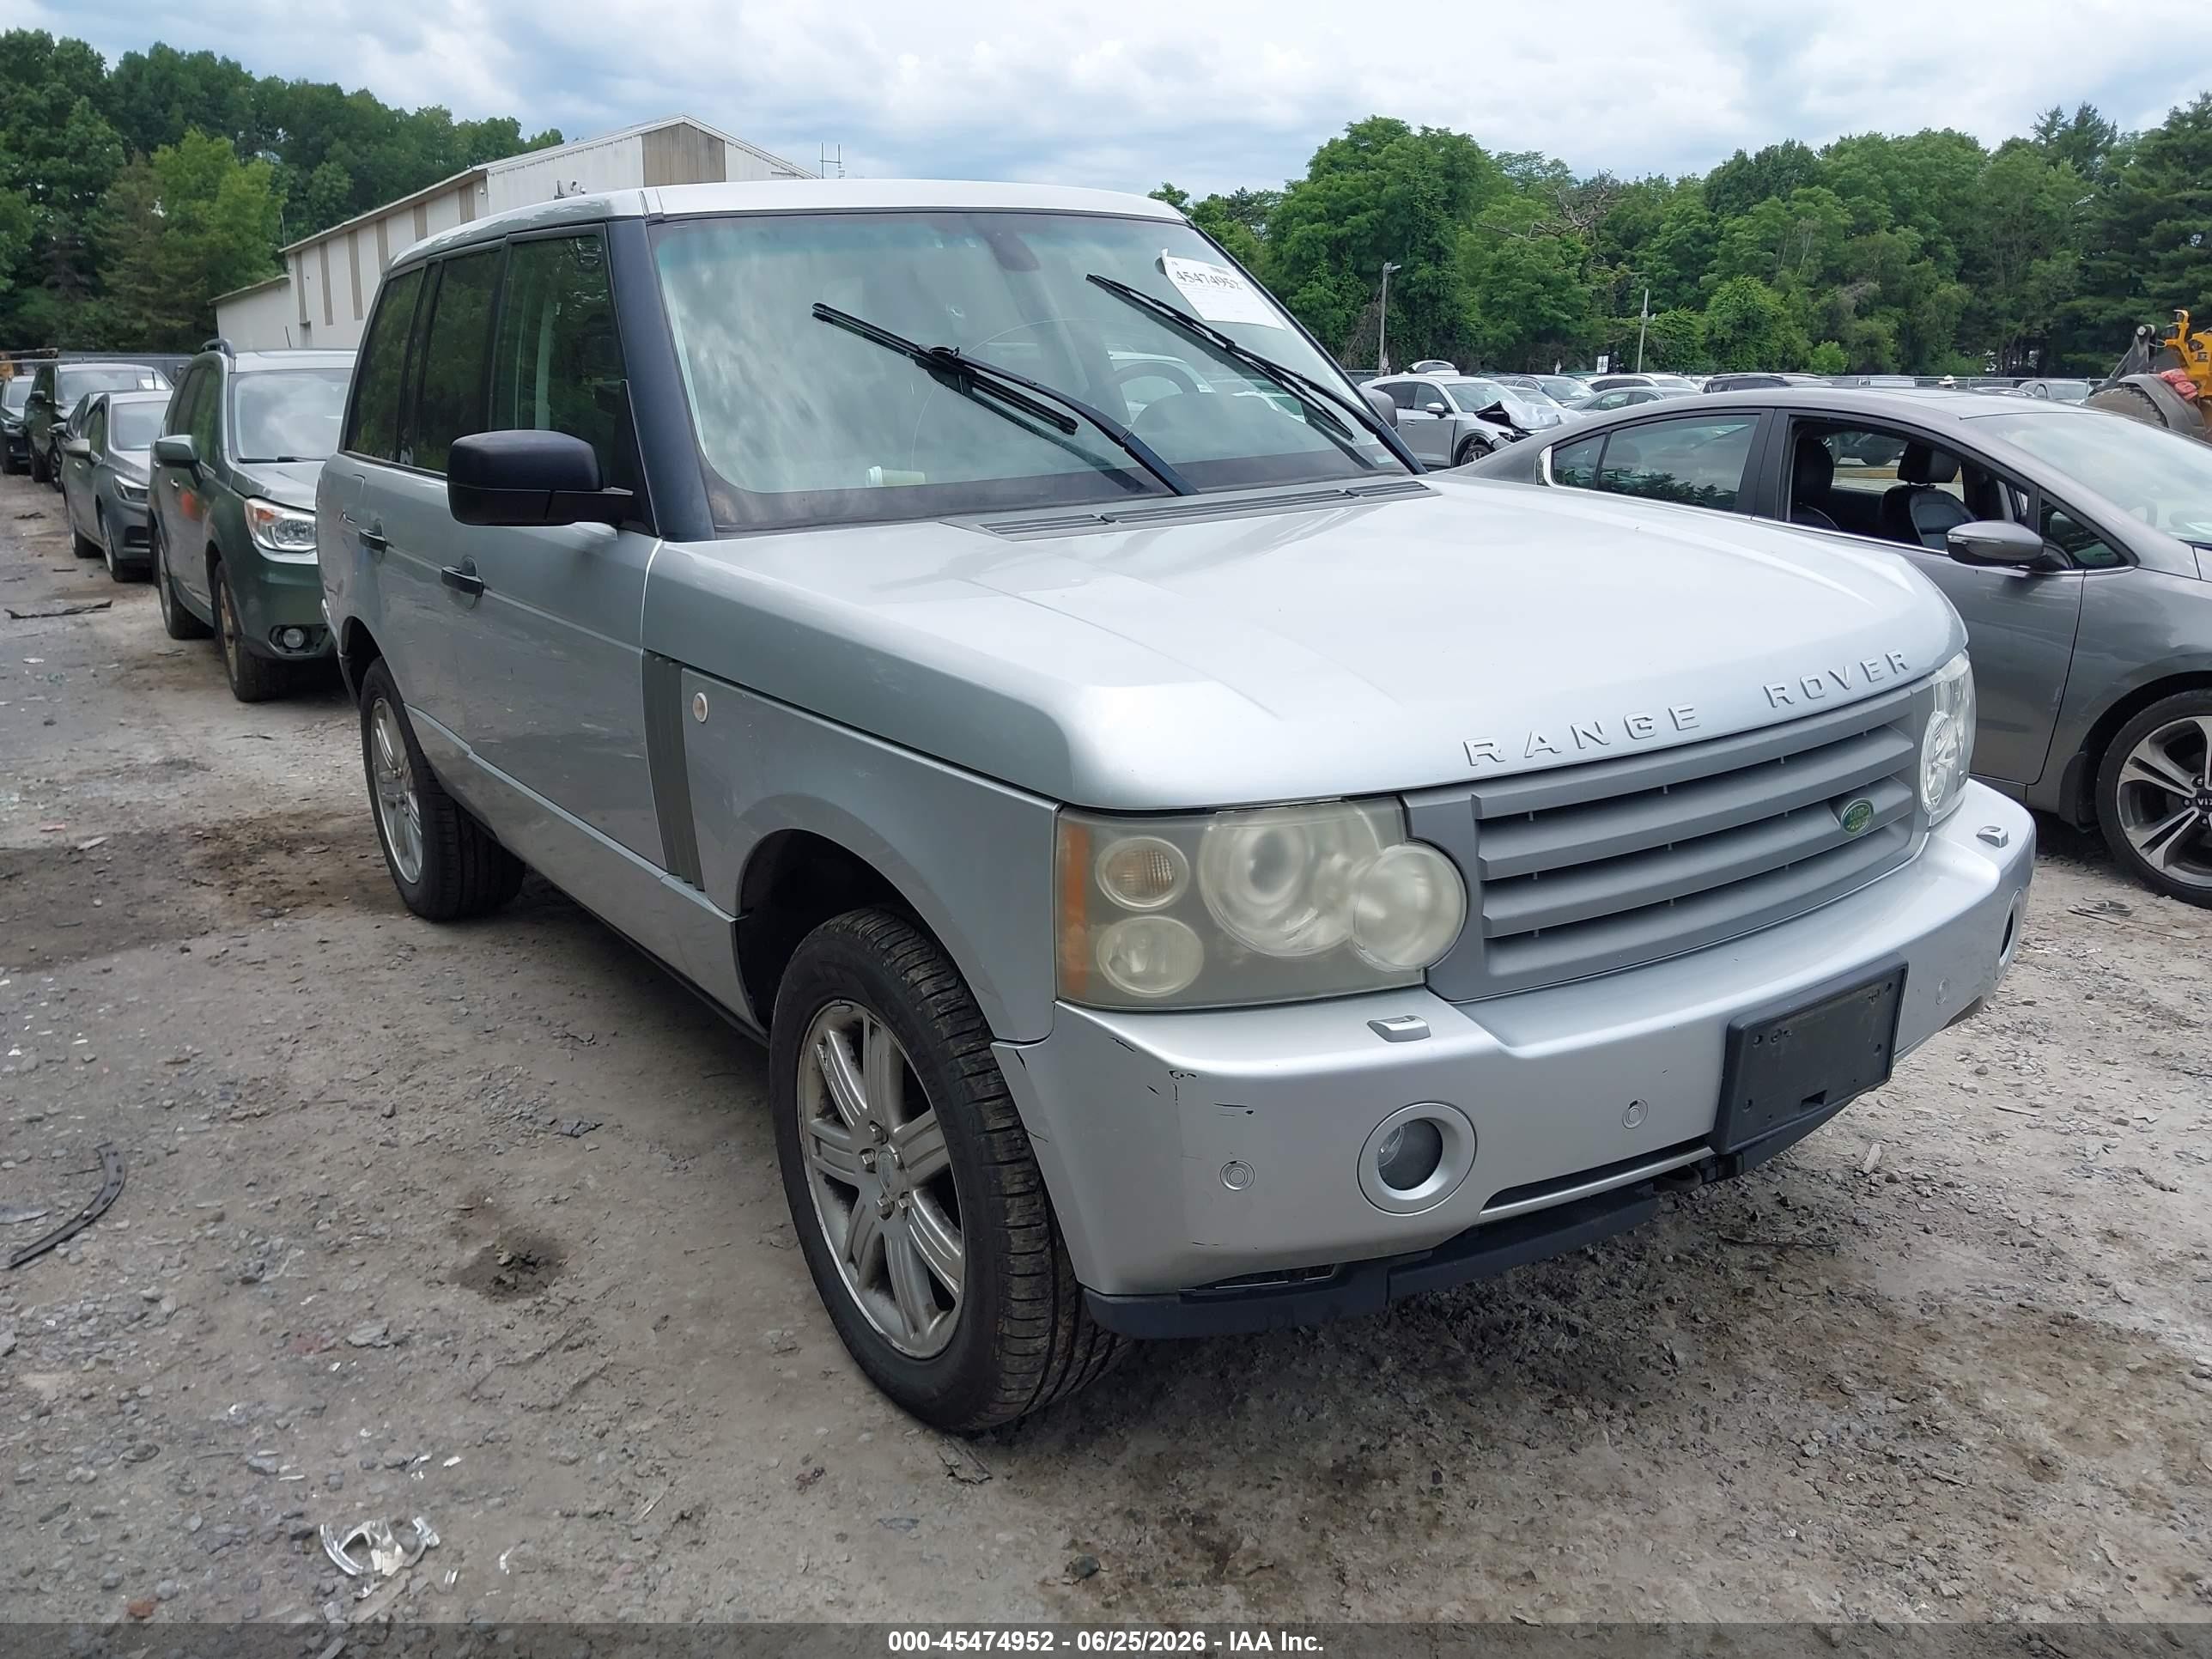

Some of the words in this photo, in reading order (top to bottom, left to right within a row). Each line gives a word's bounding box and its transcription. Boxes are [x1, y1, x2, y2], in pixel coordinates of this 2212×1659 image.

[1176, 270, 1243, 290] 45474952
[1463, 702, 1700, 767] RANGE
[1763, 649, 1911, 708] ROVER
